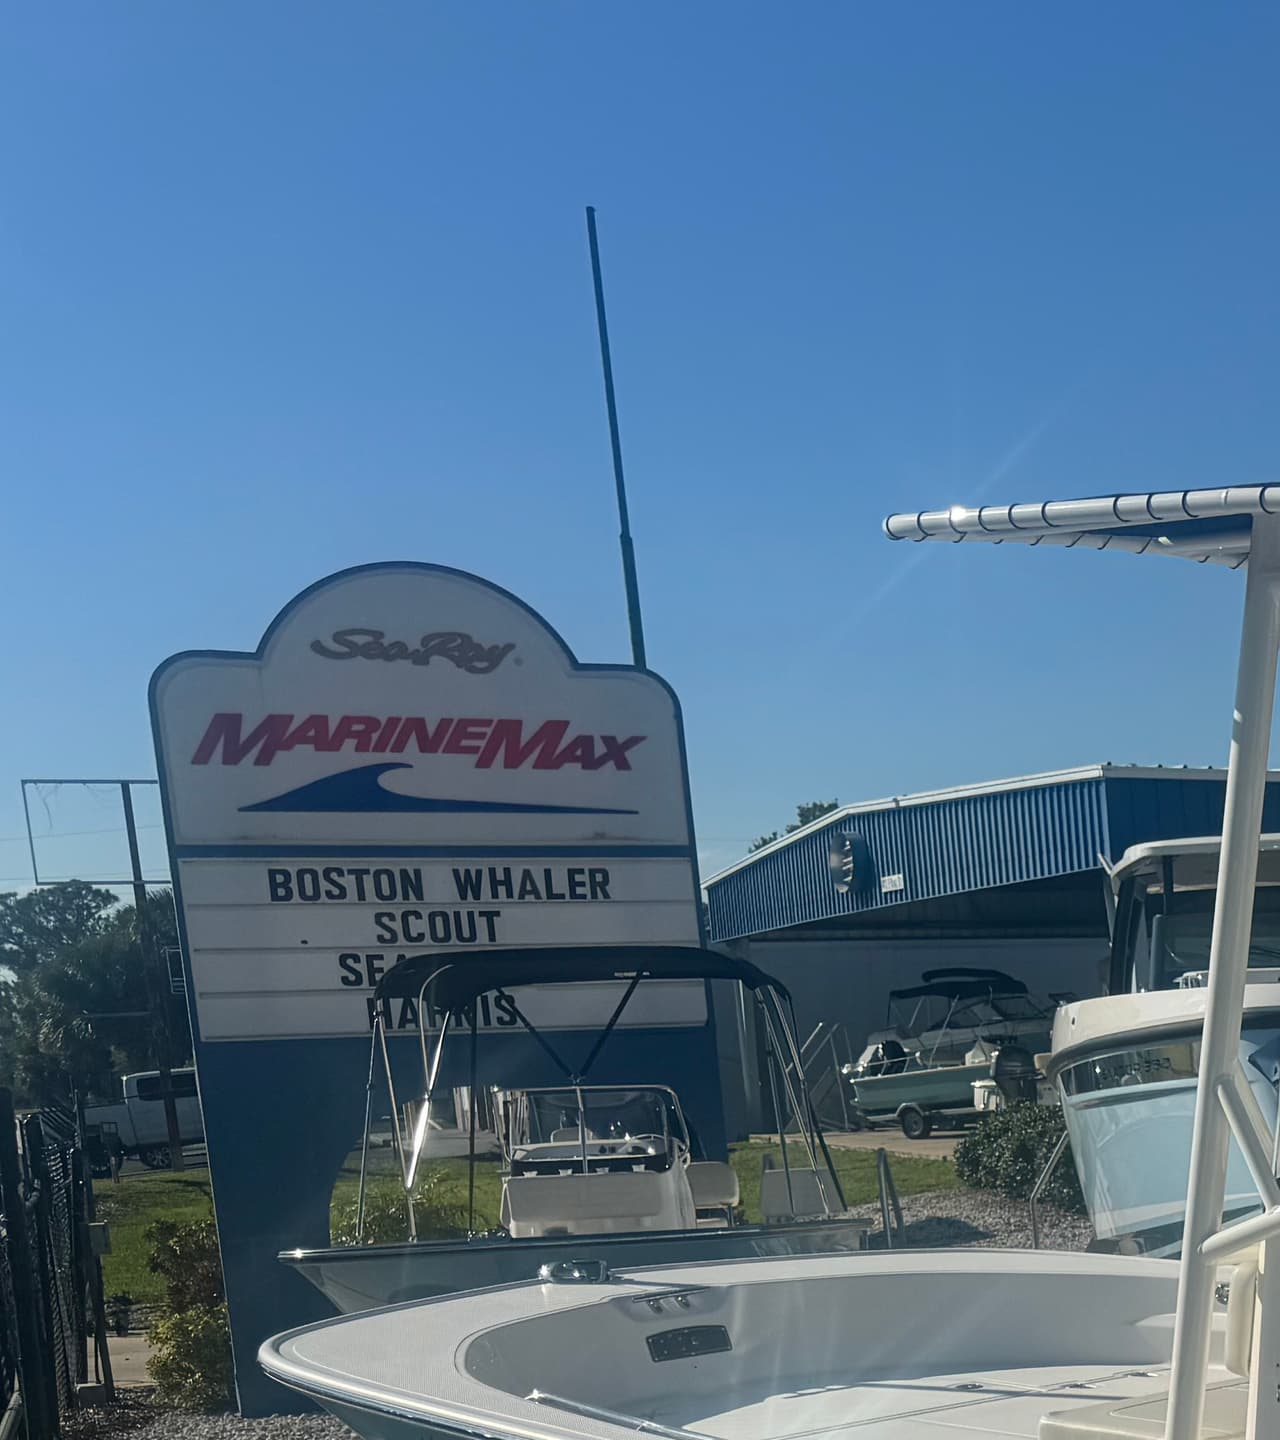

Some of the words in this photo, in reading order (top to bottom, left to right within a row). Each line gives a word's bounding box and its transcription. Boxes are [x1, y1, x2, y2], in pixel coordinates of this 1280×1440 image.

[191, 713, 647, 771] MARINEMAX
[268, 867, 423, 902] BOSTON
[453, 866, 611, 900] WHALER
[376, 910, 501, 945] SCOUT
